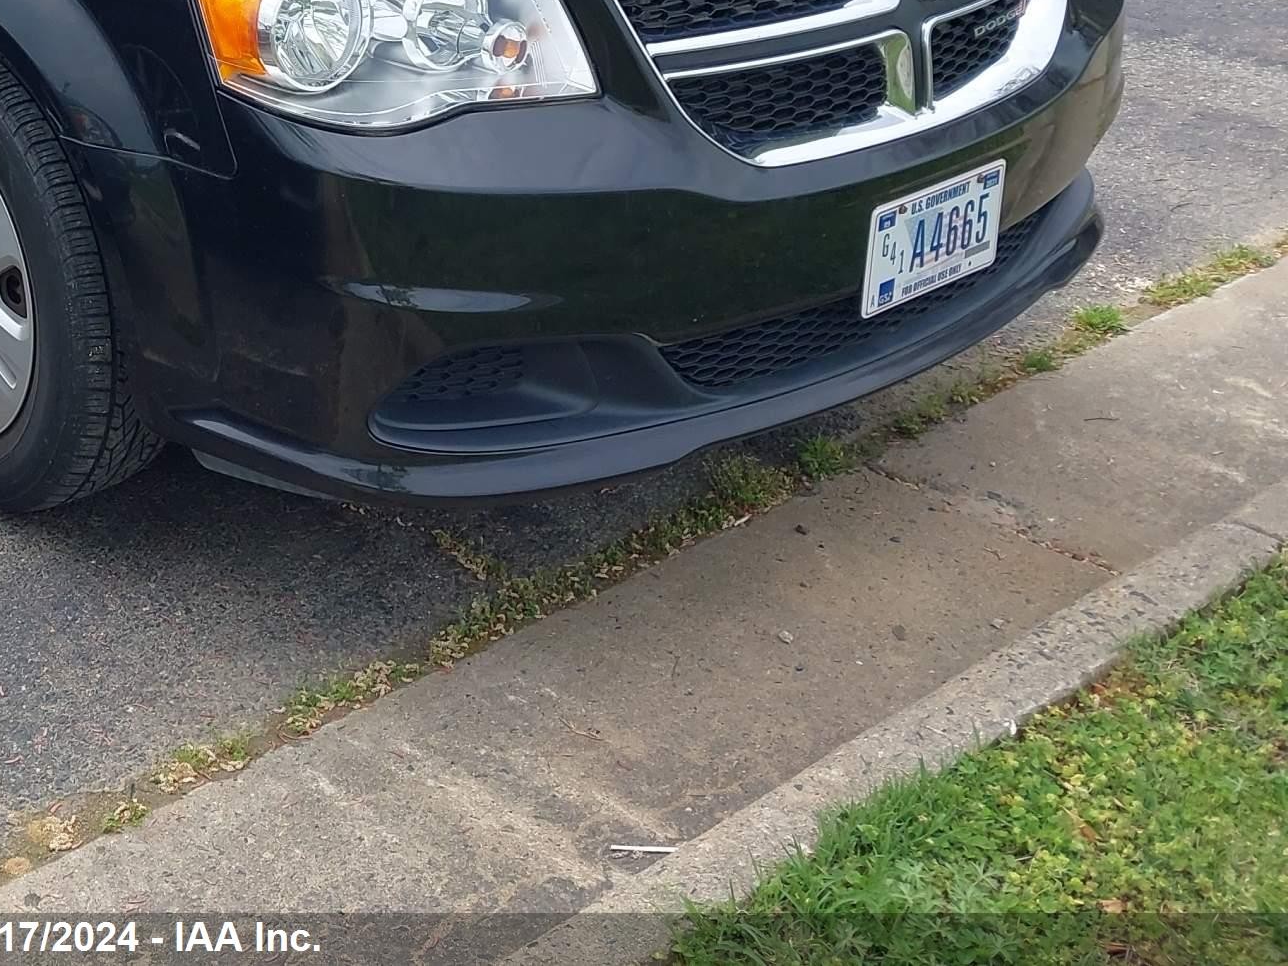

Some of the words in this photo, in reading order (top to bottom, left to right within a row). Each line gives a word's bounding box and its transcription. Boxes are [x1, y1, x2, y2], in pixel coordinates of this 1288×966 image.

[974, 8, 1022, 38] DODGE
[911, 199, 924, 215] U.S.
[925, 181, 971, 209] GOVERNMENT
[909, 192, 990, 273] A4665
